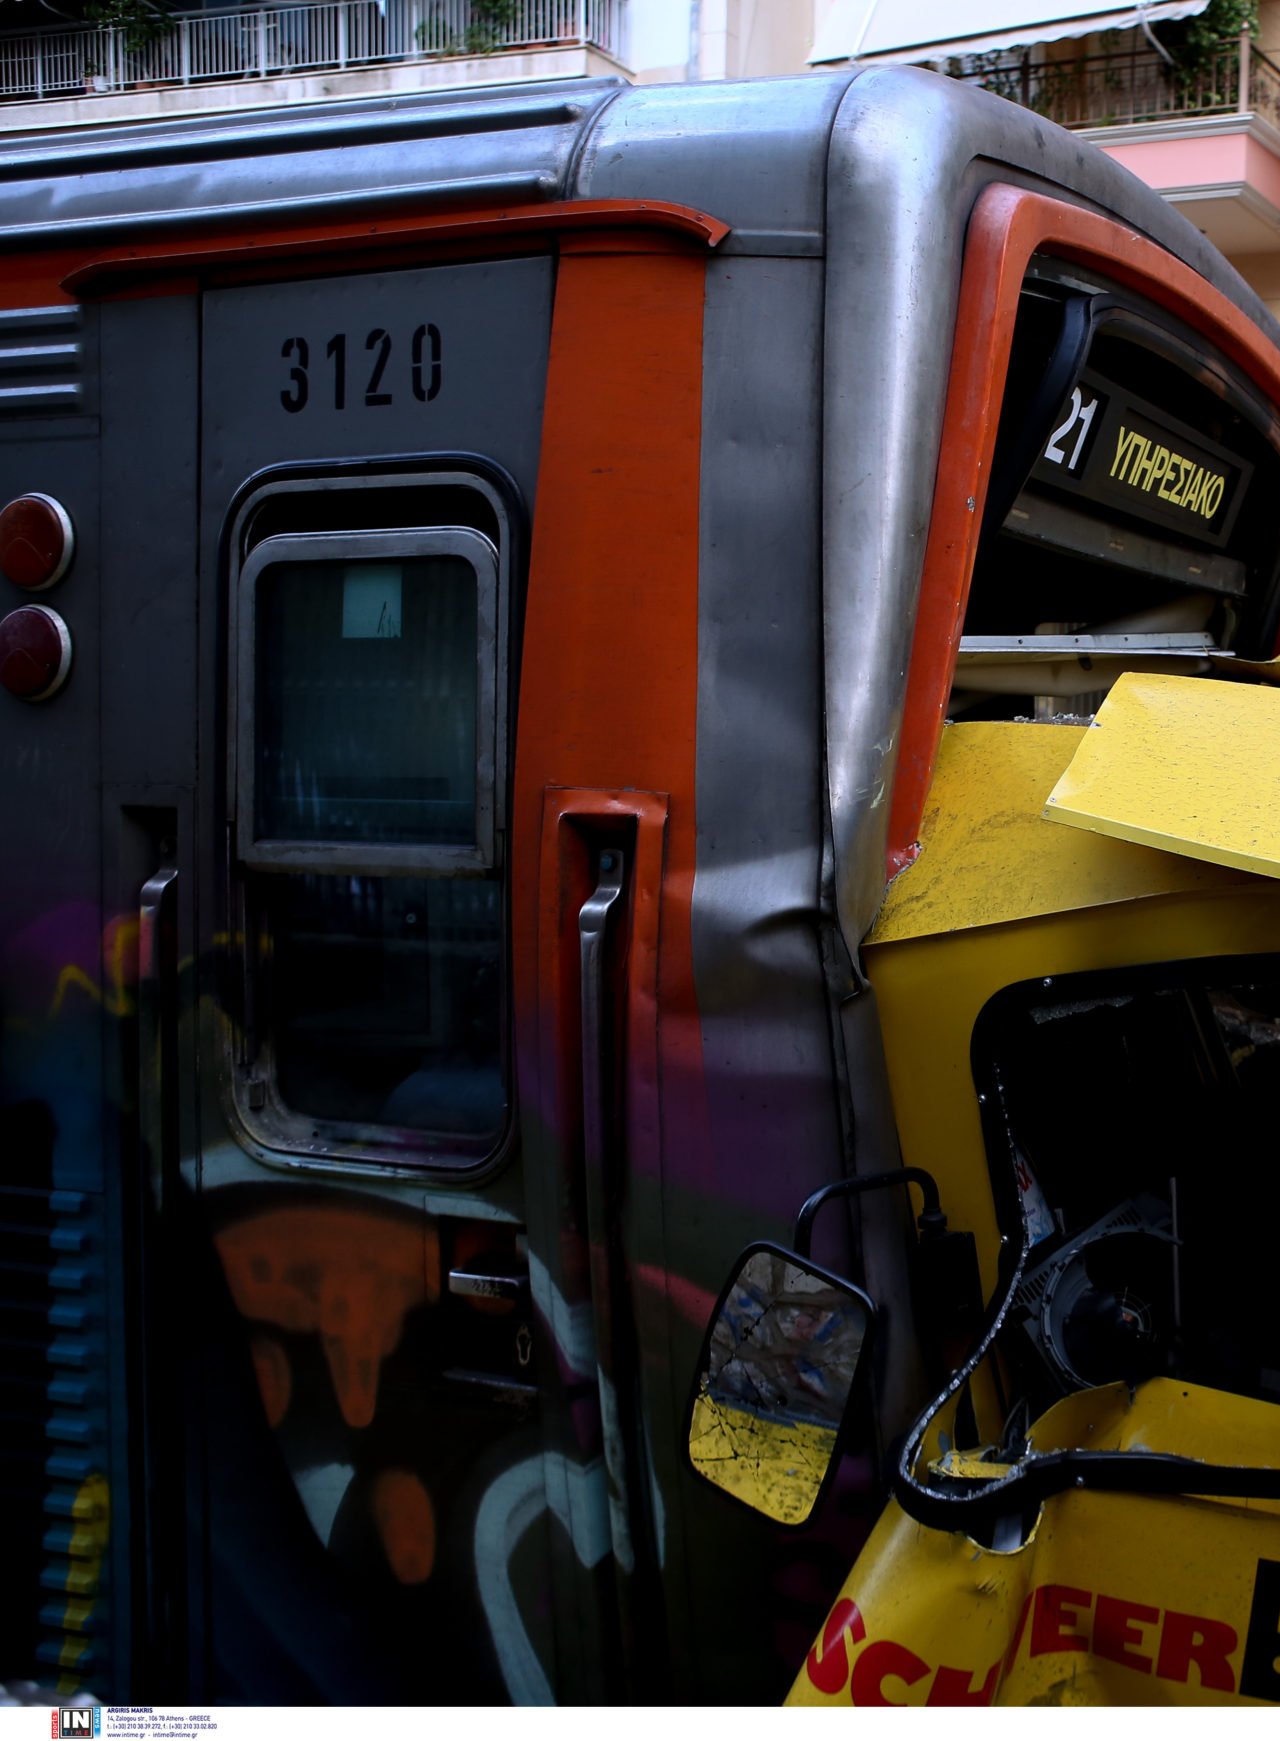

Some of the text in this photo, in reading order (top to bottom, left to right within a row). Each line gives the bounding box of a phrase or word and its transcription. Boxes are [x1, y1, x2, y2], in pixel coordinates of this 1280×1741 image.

[280, 323, 442, 413] 3120
[1043, 386, 1099, 470] 21
[1109, 425, 1225, 519] ΥΠΗΡΕΣΙΑΚΟ
